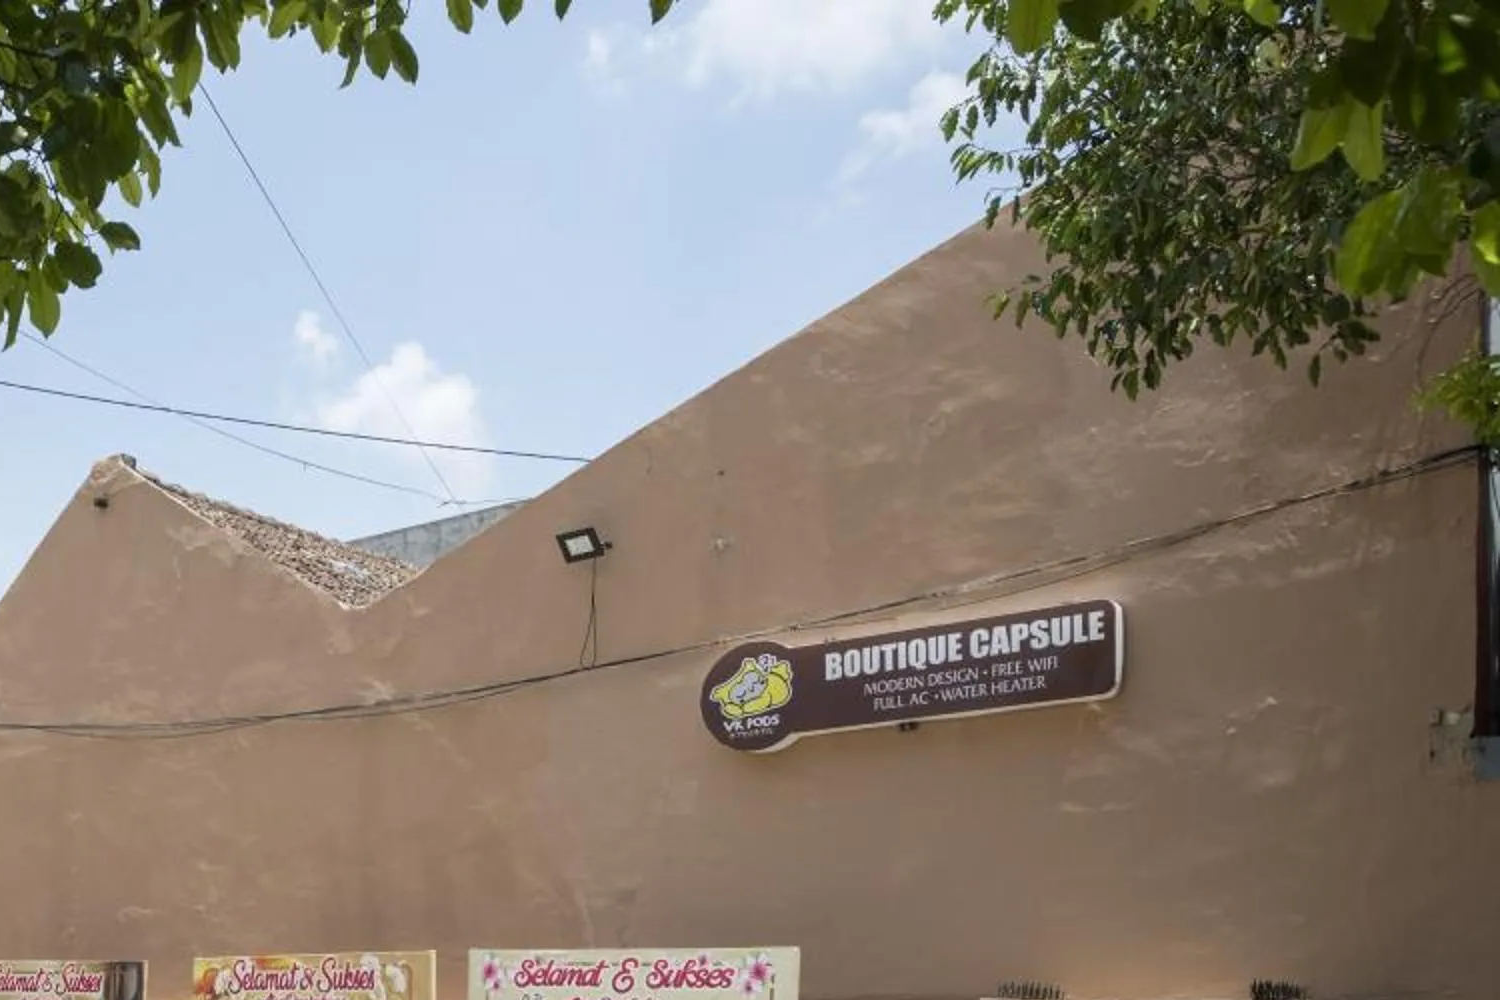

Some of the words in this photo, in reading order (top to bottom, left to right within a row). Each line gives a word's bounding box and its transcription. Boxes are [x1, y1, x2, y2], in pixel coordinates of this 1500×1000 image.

[824, 631, 963, 681] BOUTIQUE
[969, 610, 1105, 659] CAPSULE
[864, 676, 925, 696] MODERN
[928, 667, 979, 687] DESIGN
[992, 662, 1024, 677] FREE
[1028, 656, 1059, 673] WIFI
[873, 695, 905, 711] FULL
[909, 692, 930, 706] AC
[940, 683, 988, 702] WATER
[991, 676, 1046, 695] HEATER
[723, 720, 744, 733] VK
[747, 714, 780, 729] PODS
[228, 959, 300, 994] Selamat
[317, 957, 375, 993] Sukses
[514, 958, 609, 988] Selamat
[646, 958, 735, 990] Sukses
